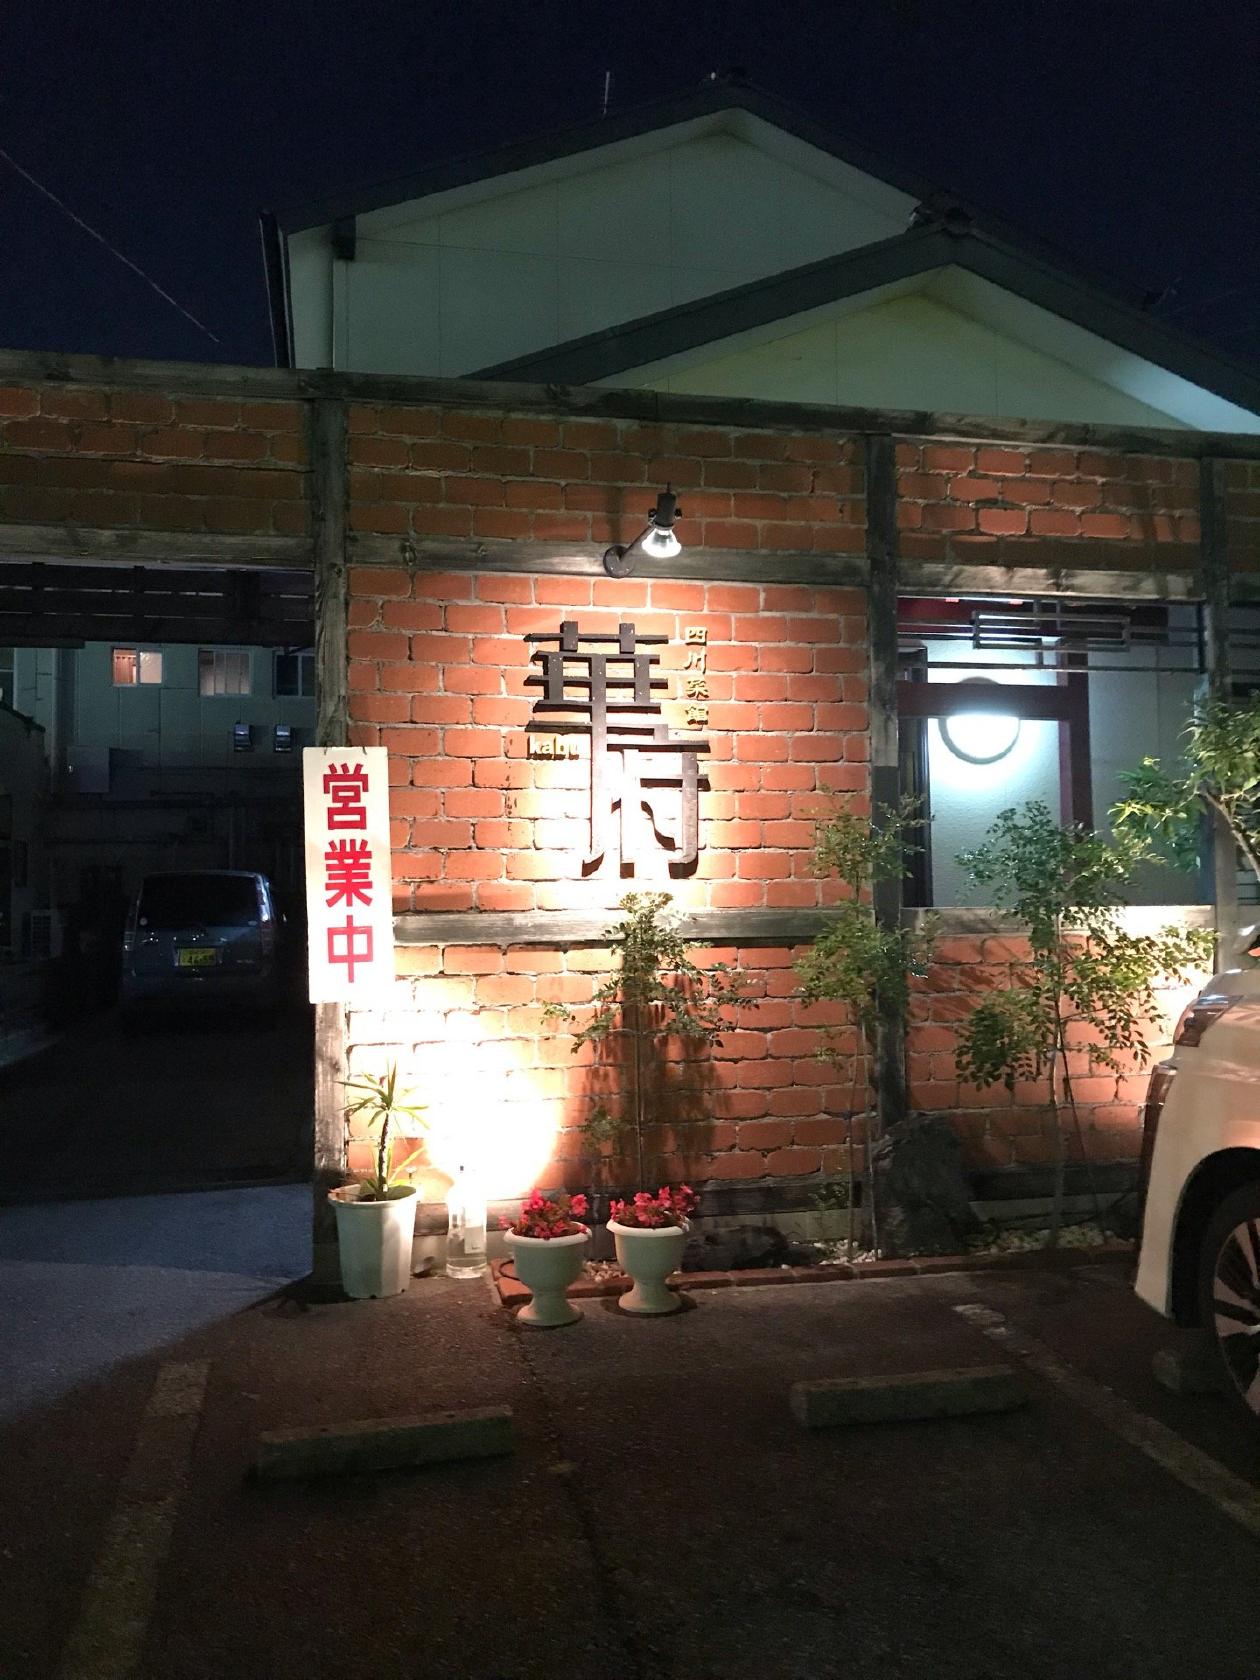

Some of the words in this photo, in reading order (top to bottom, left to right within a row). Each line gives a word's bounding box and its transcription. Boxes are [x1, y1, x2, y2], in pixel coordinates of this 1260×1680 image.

[526, 735, 580, 761] kabu
[323, 762, 375, 984] 営業中
